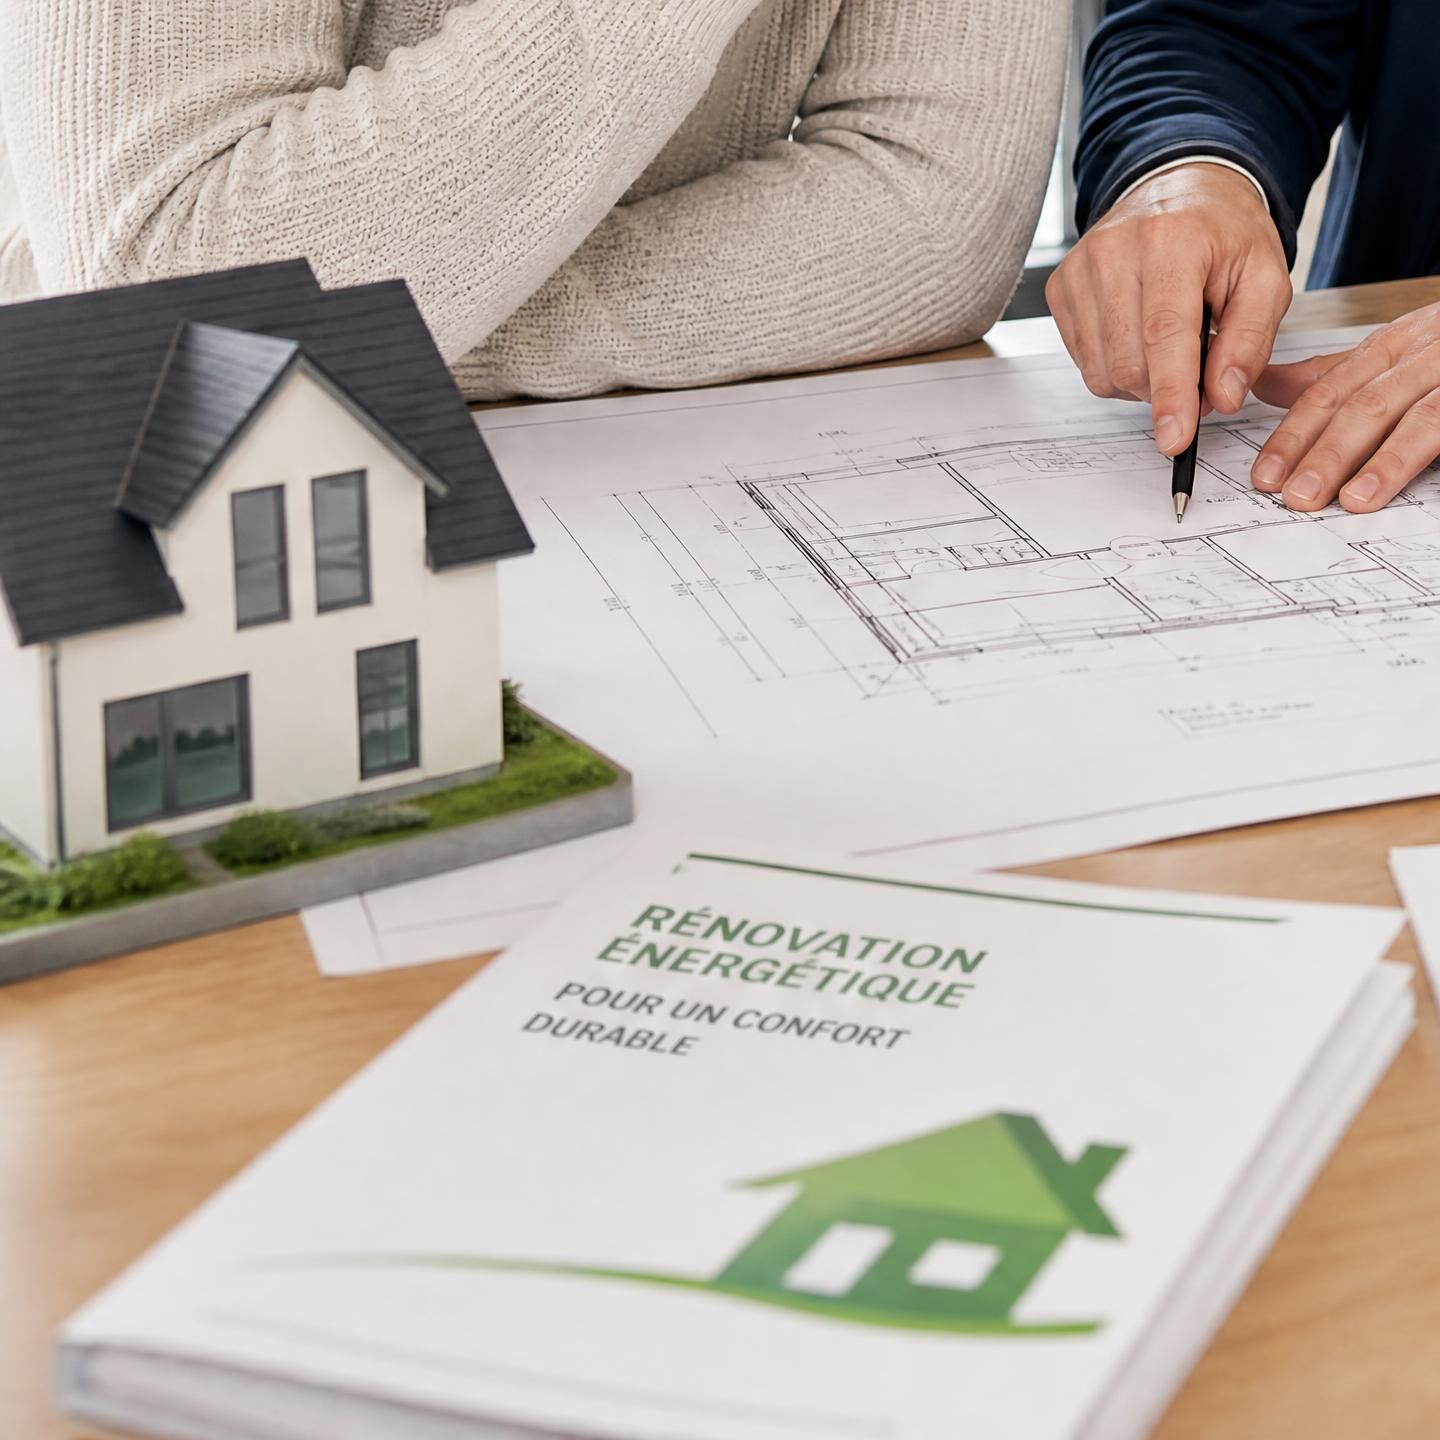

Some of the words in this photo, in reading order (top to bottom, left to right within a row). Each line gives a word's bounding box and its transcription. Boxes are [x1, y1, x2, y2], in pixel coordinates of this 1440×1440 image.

[596, 933, 975, 1009] ÉNERGÉTIQUE
[630, 904, 988, 975] RÉNOVATION
[521, 1012, 700, 1056] DURABLE
[553, 982, 664, 1016] POUR
[669, 1000, 726, 1024] UN
[732, 1009, 911, 1051] CONFORT
